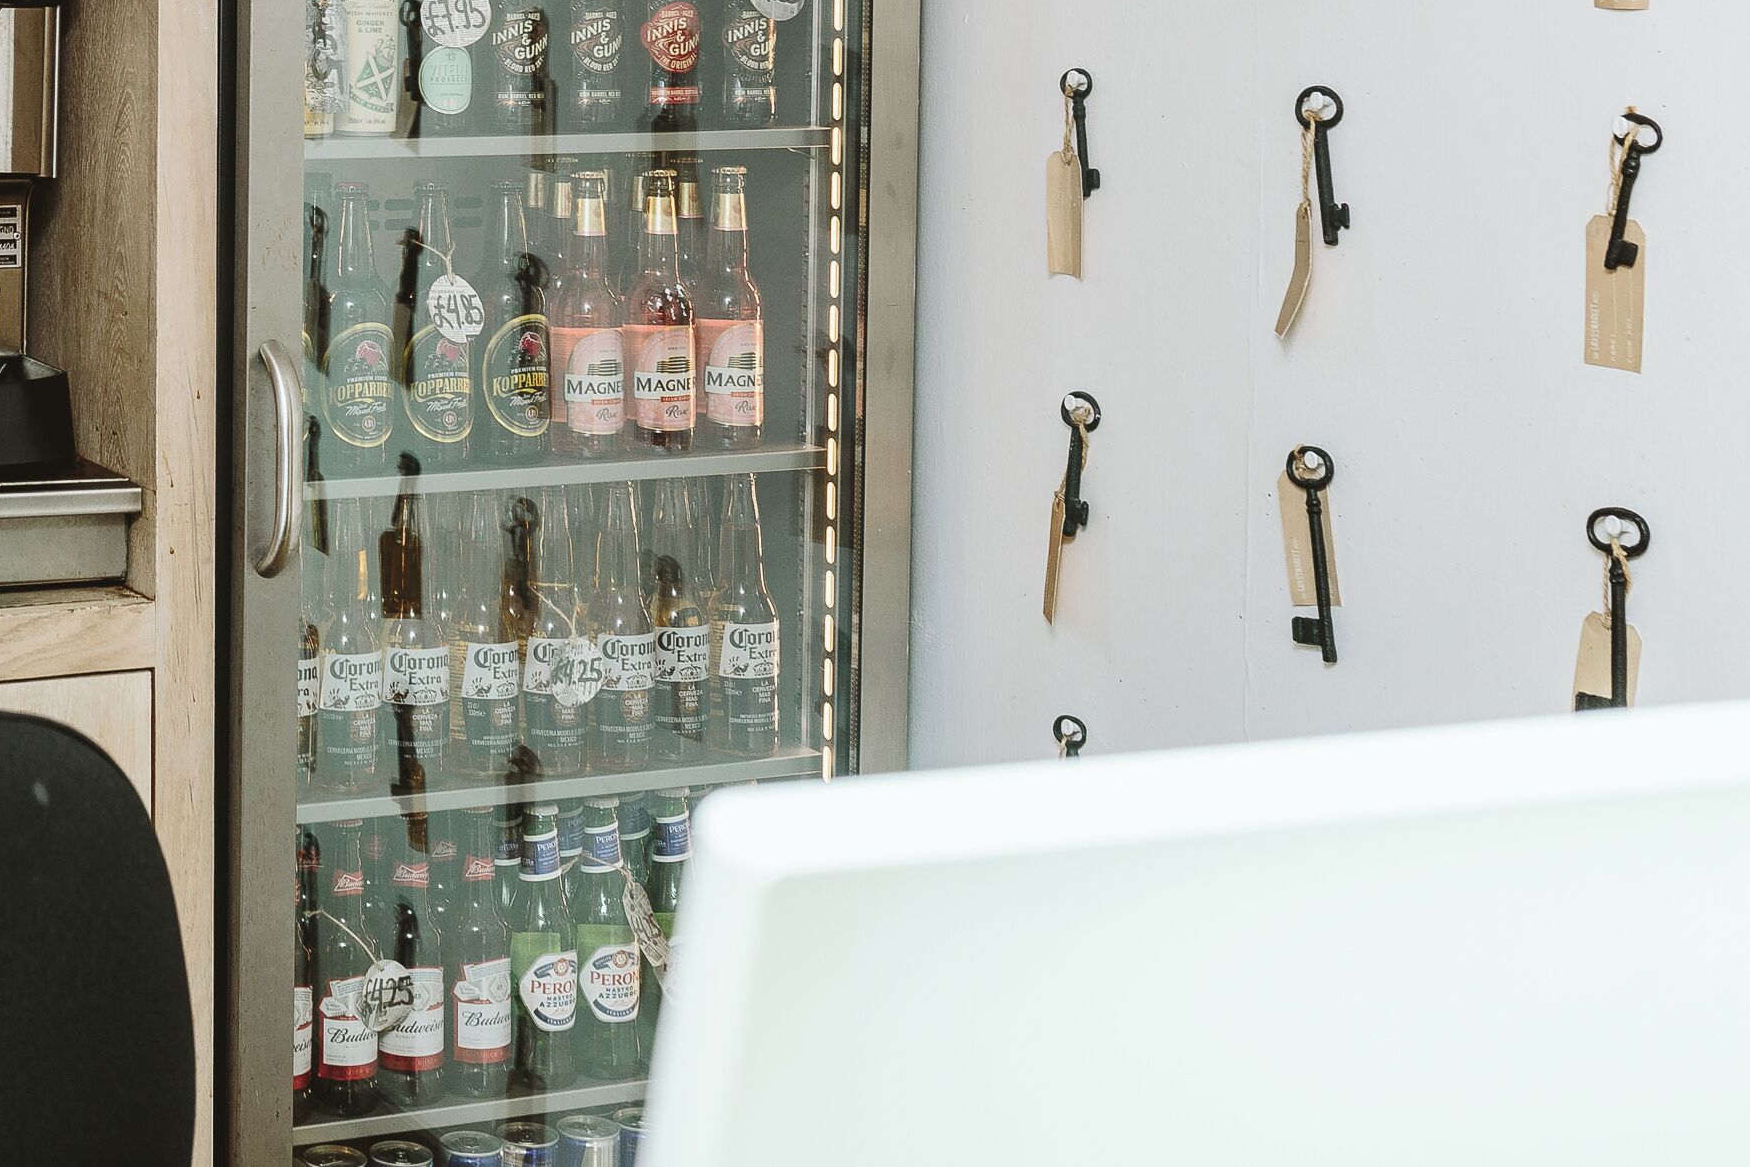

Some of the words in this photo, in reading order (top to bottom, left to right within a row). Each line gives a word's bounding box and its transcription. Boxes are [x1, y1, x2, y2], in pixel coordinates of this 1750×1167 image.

[356, 19, 385, 27] GINGER
[646, 17, 688, 42] INNIS
[727, 17, 768, 43] INNIS
[492, 20, 534, 47] INNIS
[570, 19, 611, 45] INNIS
[599, 32, 610, 45] &
[514, 34, 549, 60] GUNN
[520, 34, 532, 46] &
[432, 293, 483, 331] £4.85
[676, 649, 707, 664] Extra
[621, 657, 652, 673] Extra
[349, 677, 379, 692] Extra
[408, 671, 442, 685] Extra
[605, 985, 634, 993] NASTRO
